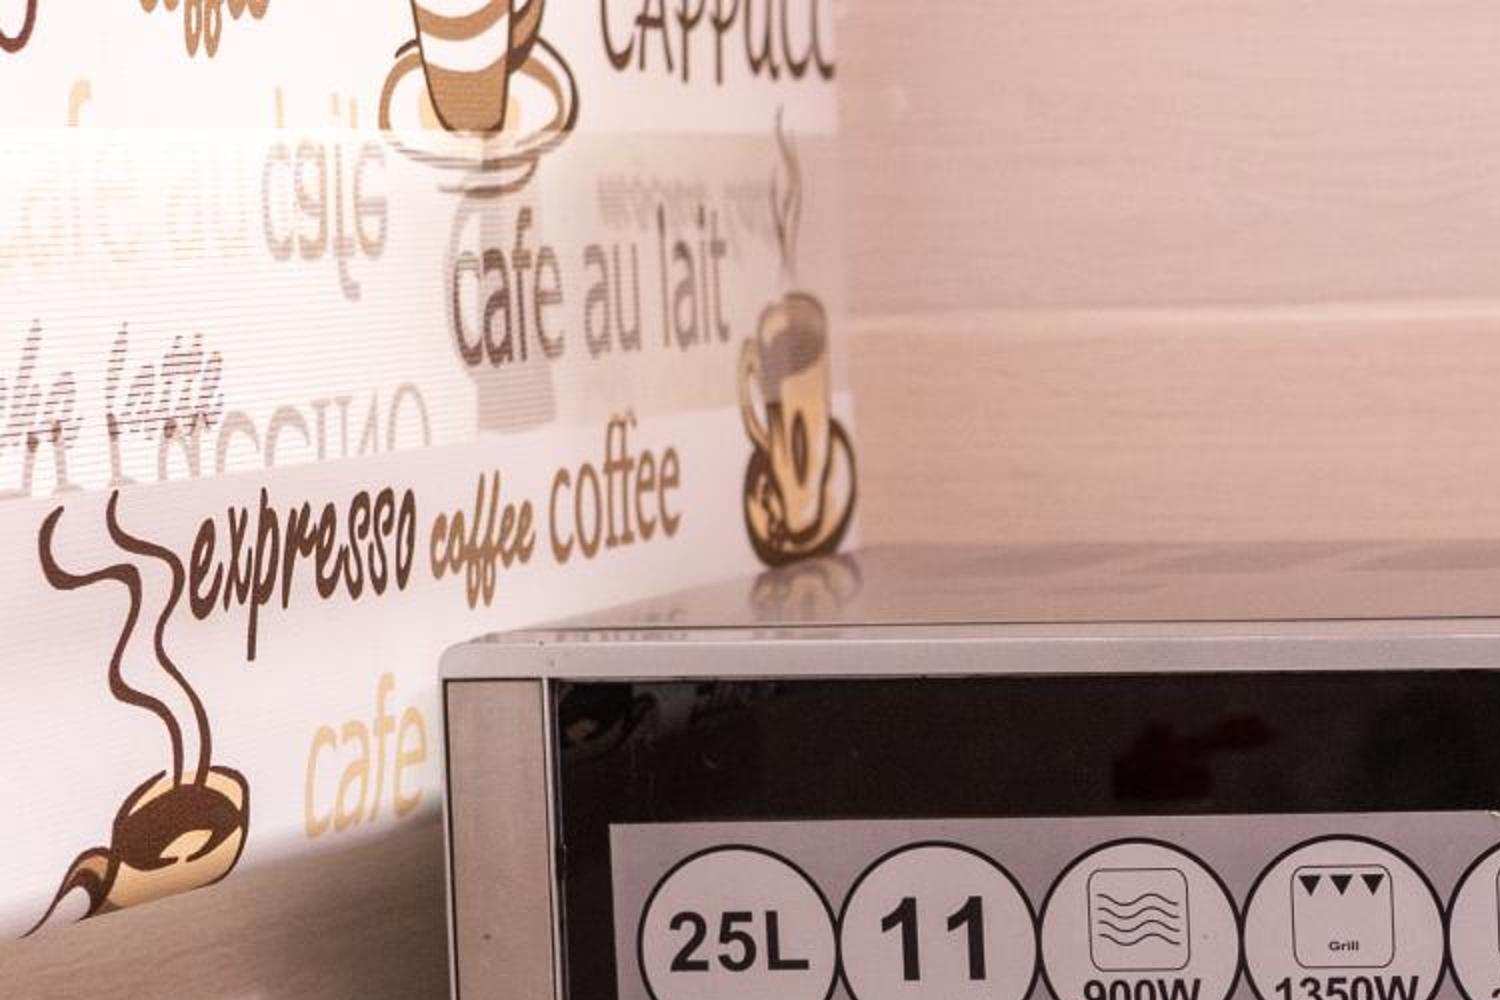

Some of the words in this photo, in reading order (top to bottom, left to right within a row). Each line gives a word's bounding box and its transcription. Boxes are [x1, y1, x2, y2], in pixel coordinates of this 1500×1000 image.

[453, 206, 564, 367] cafe
[584, 244, 643, 360] au
[658, 201, 731, 352] lait
[189, 487, 416, 661] expresso
[430, 470, 536, 609] coffee
[549, 409, 681, 564] coffee
[304, 672, 428, 838] cafe
[668, 910, 810, 972] 25L
[881, 896, 986, 981] 11
[1328, 940, 1360, 952] Grill
